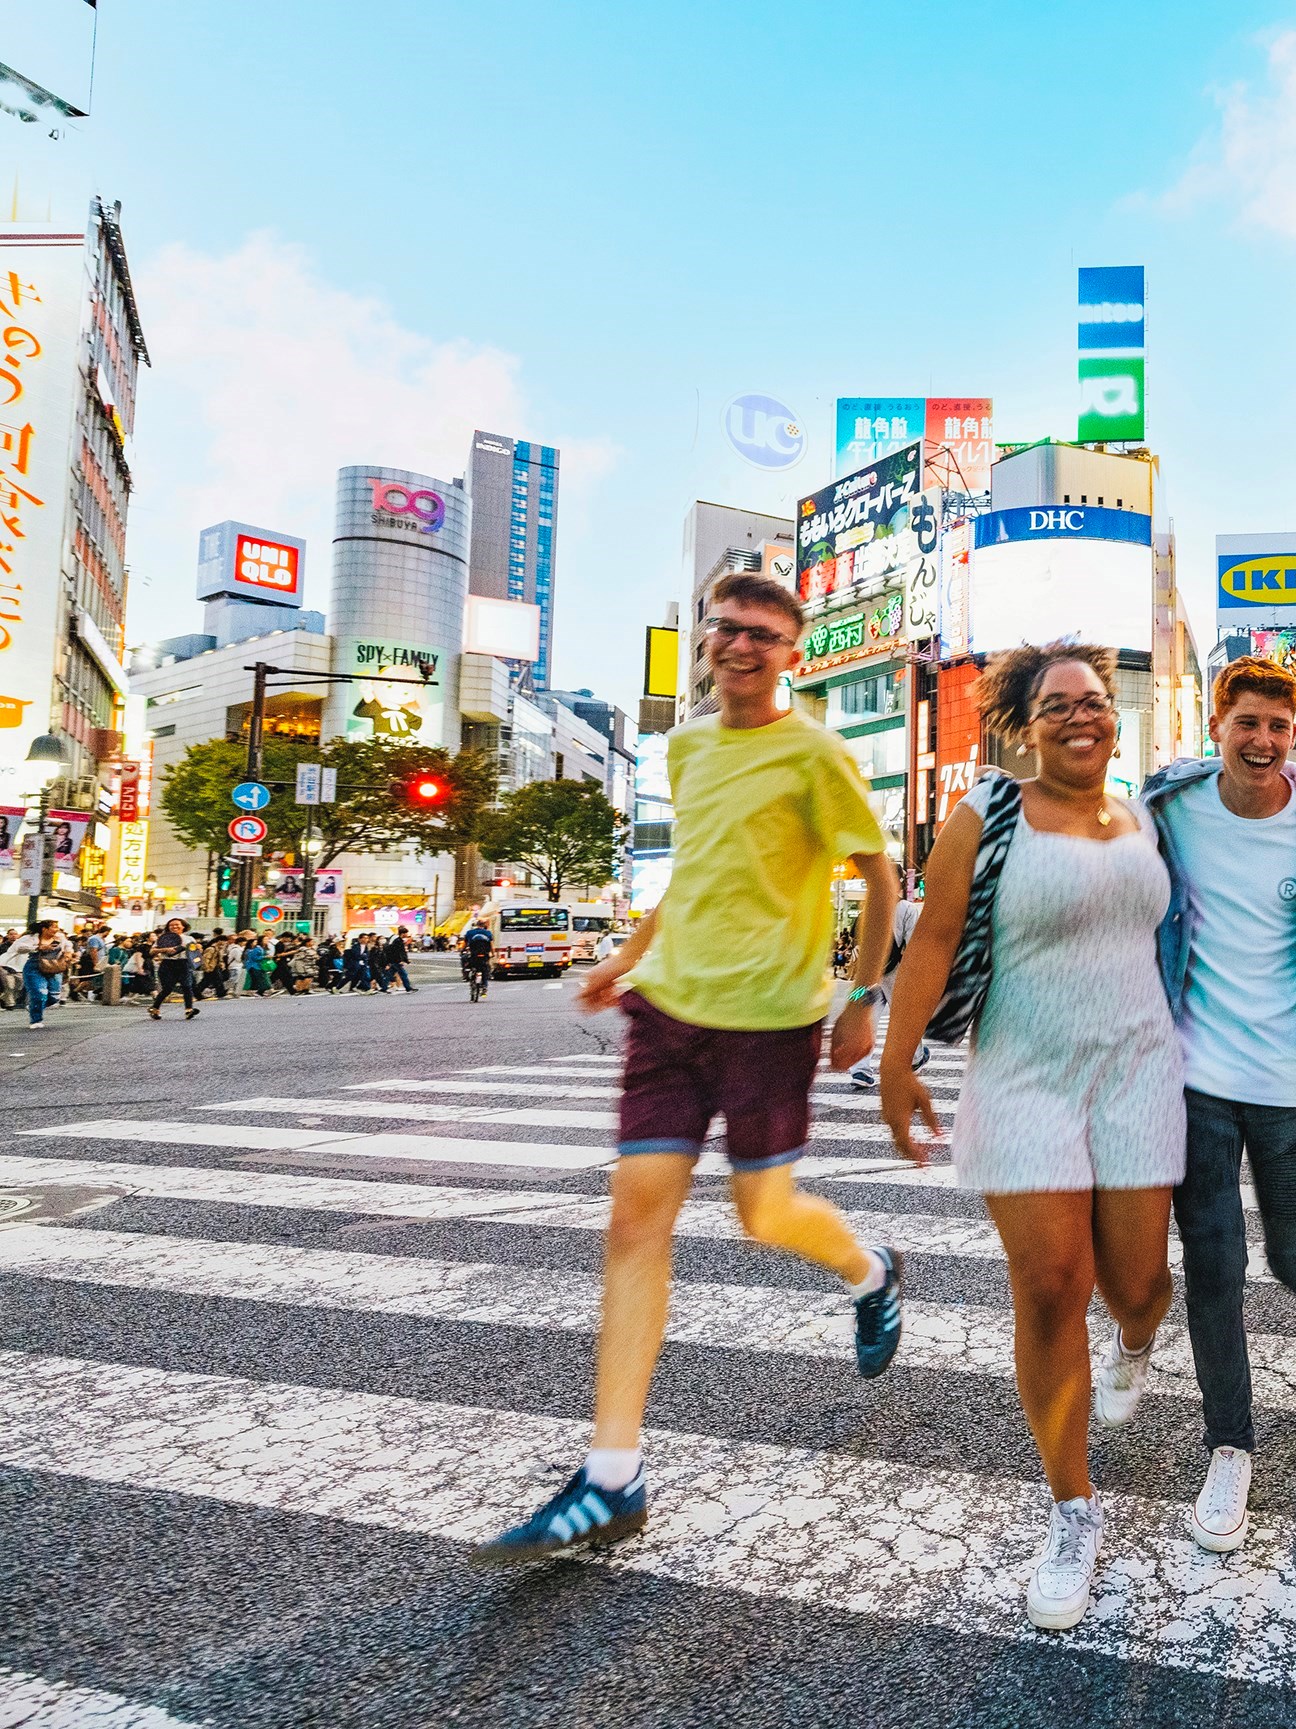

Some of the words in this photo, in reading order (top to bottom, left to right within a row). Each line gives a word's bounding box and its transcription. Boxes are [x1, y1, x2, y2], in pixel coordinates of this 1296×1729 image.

[370, 514, 418, 530] SHIBUYA
[1028, 510, 1085, 532] DHC
[241, 540, 289, 568] UNI
[240, 560, 292, 586] QLO
